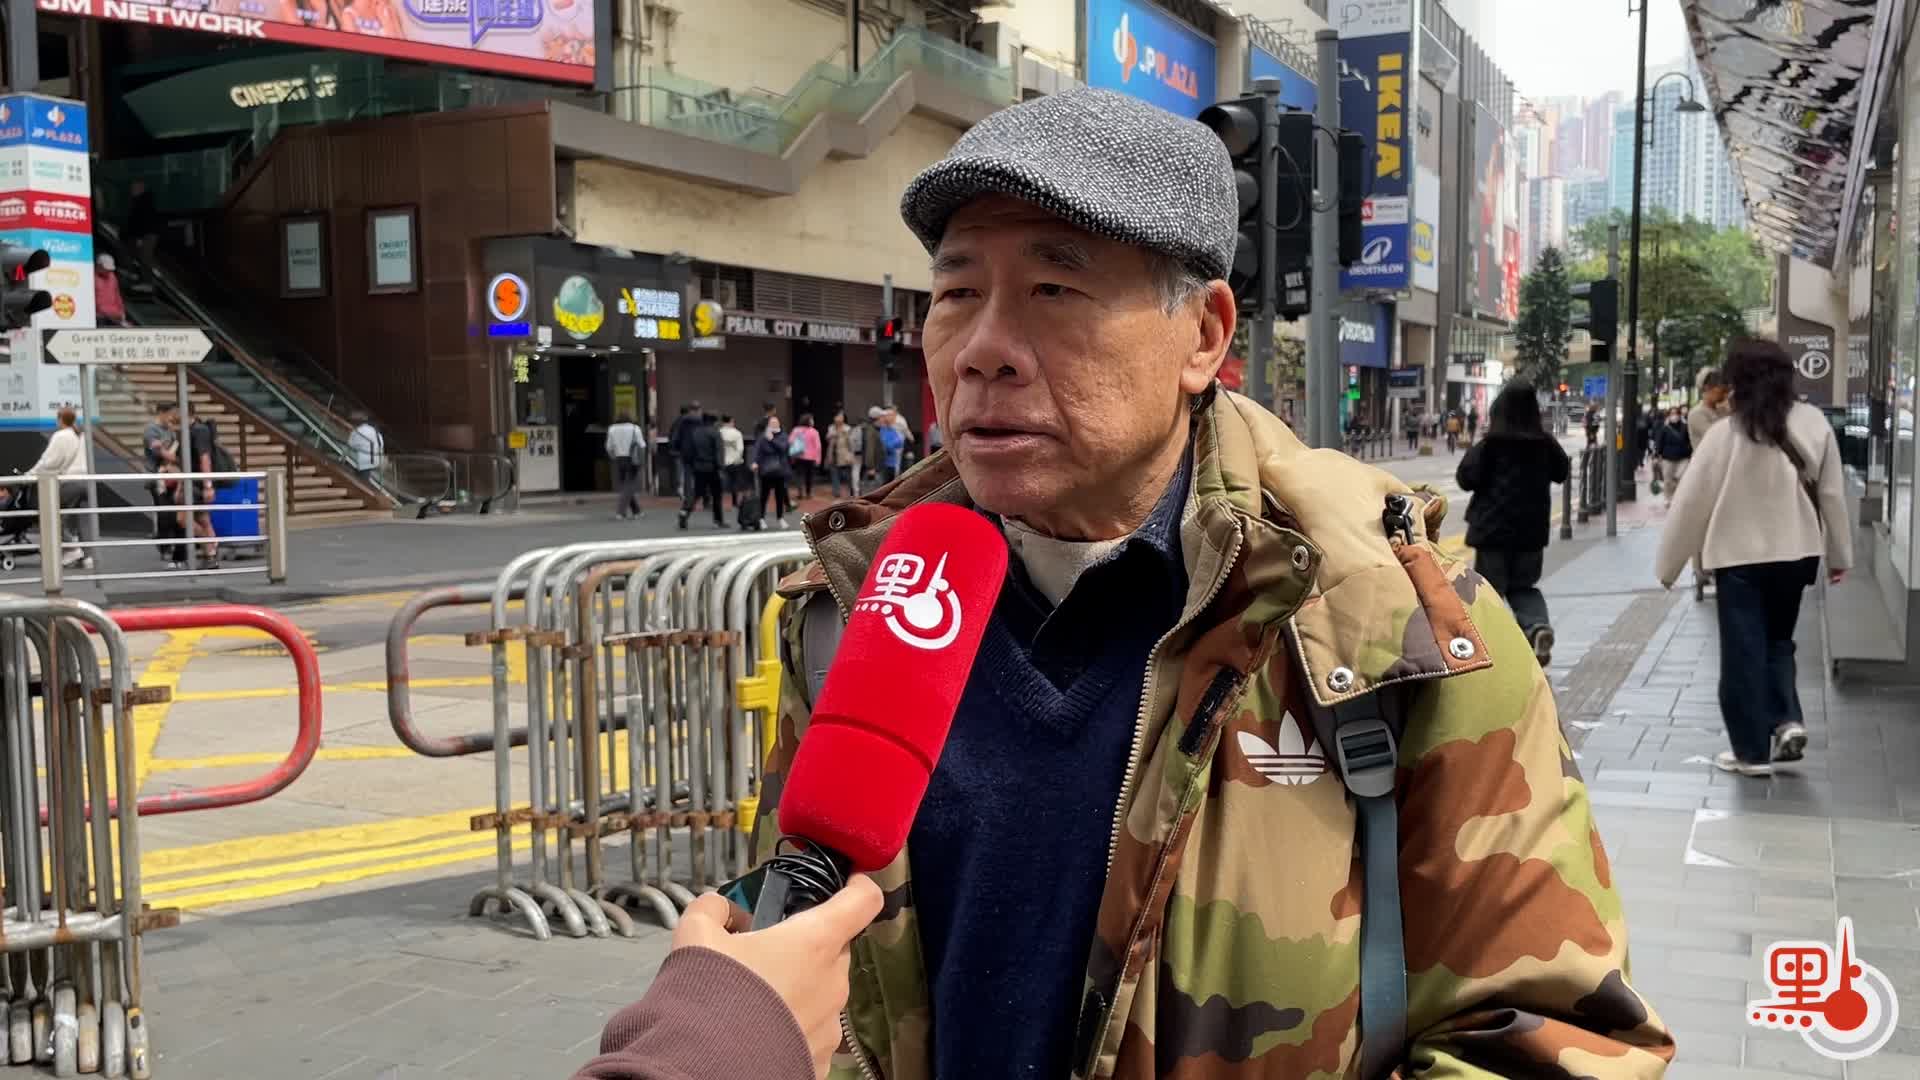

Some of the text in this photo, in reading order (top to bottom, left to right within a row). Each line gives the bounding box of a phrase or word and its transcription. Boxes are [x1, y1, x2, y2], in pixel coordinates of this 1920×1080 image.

[104, 3, 264, 37] NETWORK
[1155, 52, 1198, 99] PLAZA
[1376, 54, 1402, 177] IKEA
[45, 129, 83, 145] PLAZA
[33, 206, 88, 221] OUTBACK
[72, 333, 188, 346] Great George Street
[726, 316, 768, 335] PEARL
[773, 320, 803, 337] CITY
[807, 323, 860, 343] MANSION
